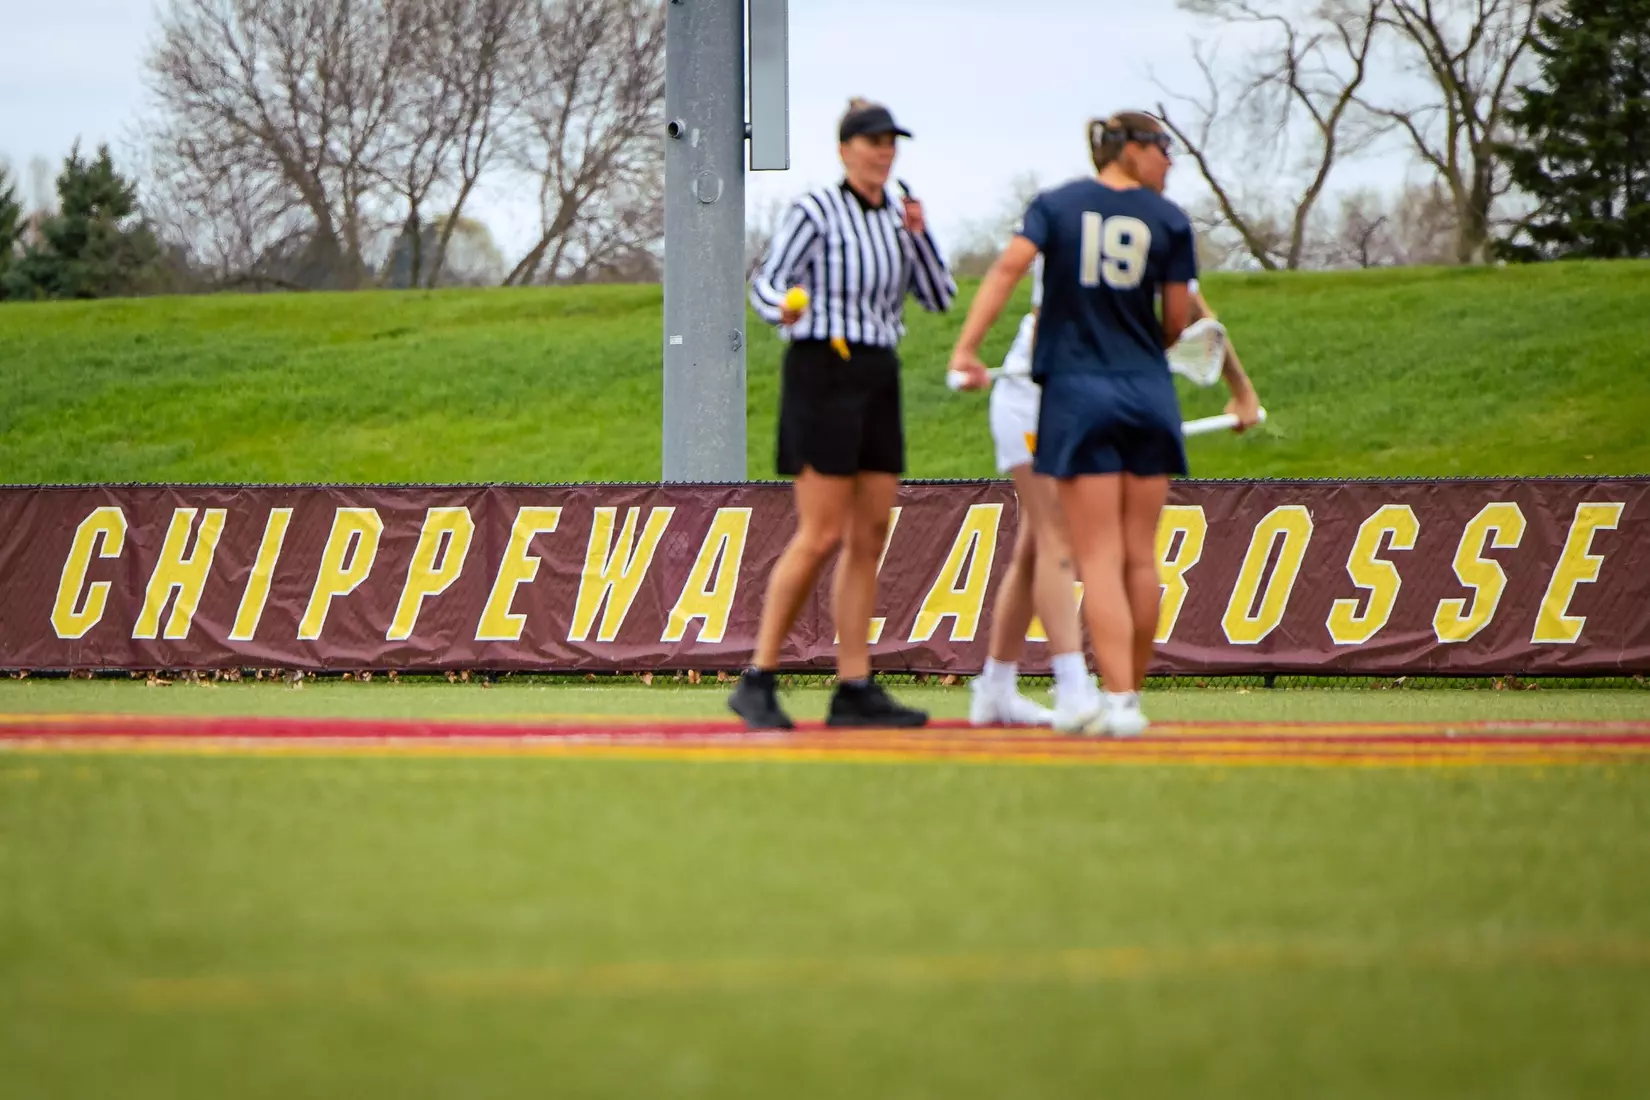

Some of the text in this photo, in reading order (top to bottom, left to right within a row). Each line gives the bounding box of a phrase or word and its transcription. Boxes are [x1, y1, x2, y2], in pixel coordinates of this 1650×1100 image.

[1079, 210, 1152, 291] 19
[50, 501, 1626, 645] CHIPPEWA AROSSE
